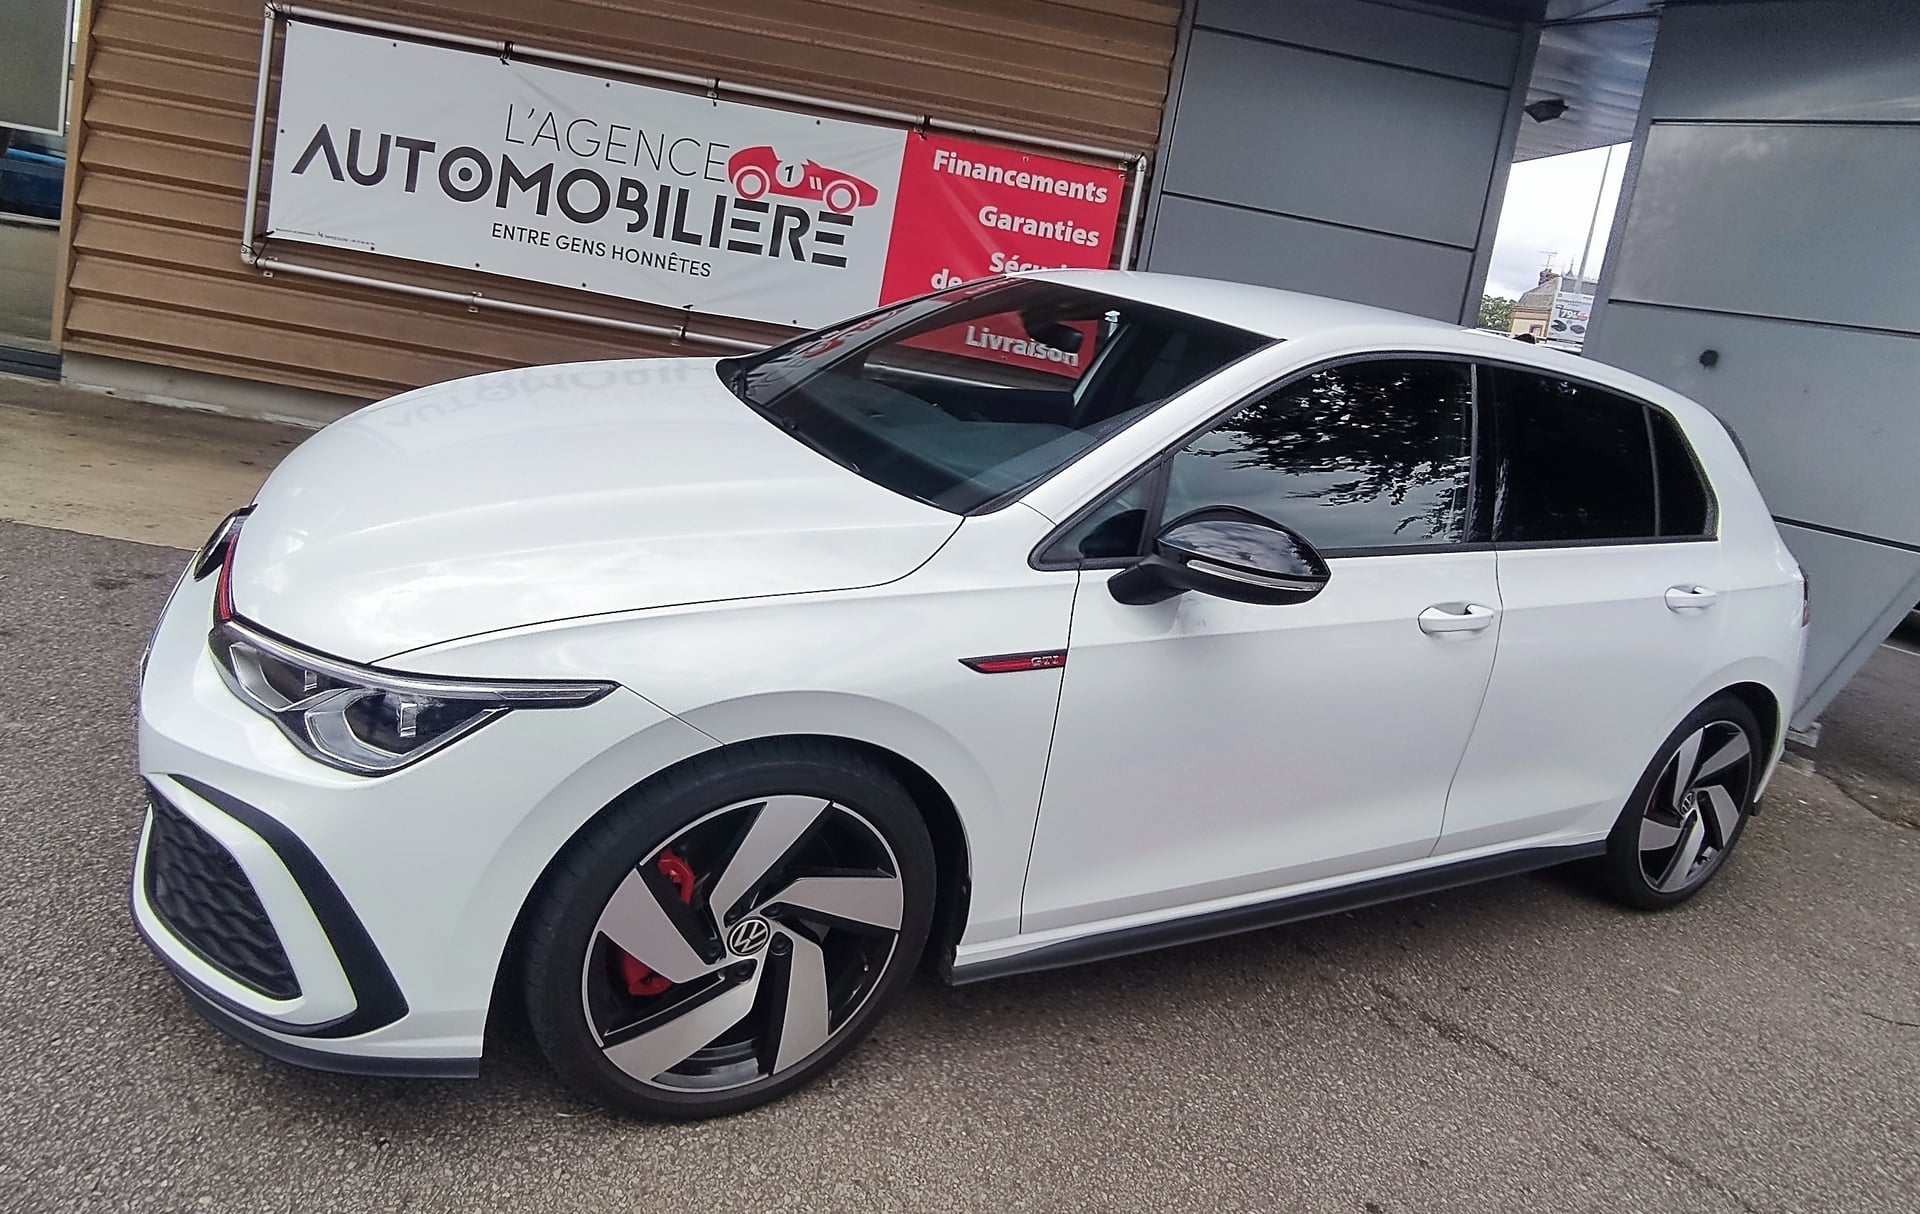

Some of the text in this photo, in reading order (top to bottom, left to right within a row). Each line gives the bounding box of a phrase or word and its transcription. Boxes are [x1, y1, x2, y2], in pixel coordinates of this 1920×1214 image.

[932, 149, 1109, 204] Financements
[491, 222, 712, 278] ENTRE GENS HONNÊTES
[978, 205, 1100, 248] Garanties
[965, 325, 1079, 367] Livraison
